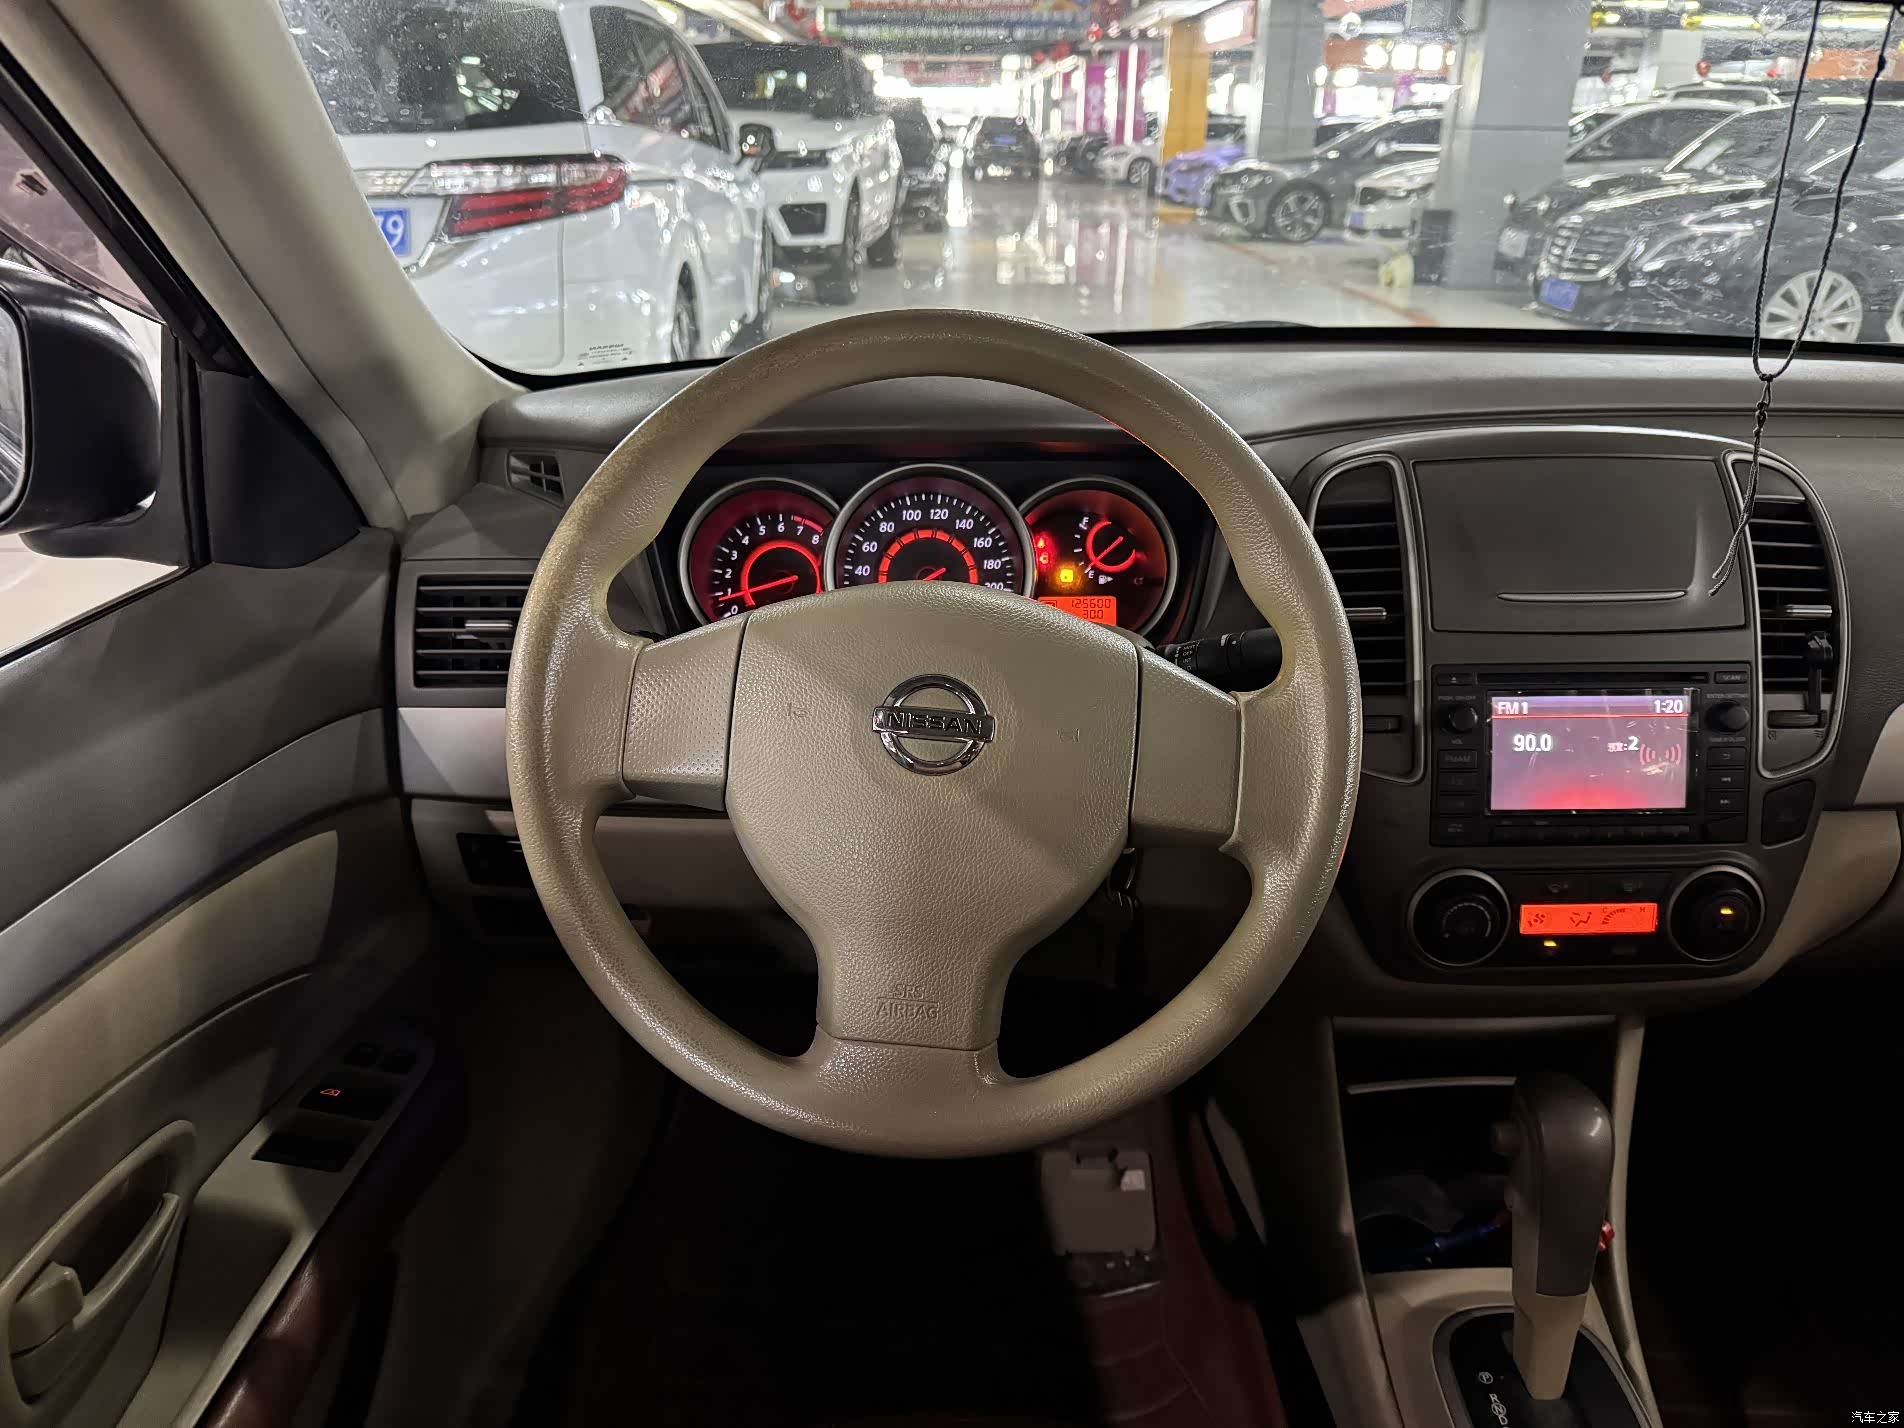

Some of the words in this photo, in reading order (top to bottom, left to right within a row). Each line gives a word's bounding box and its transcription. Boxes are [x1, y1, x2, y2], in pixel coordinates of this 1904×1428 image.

[902, 509, 922, 521] 100
[930, 508, 949, 520] 120
[955, 518, 974, 530] 140
[1082, 516, 1090, 526] F
[758, 525, 766, 536] 5
[777, 522, 785, 533] 6
[796, 525, 804, 536] 7
[879, 521, 895, 533] 80
[741, 535, 750, 545] 4
[811, 535, 820, 545] 8
[973, 537, 993, 548] 160
[861, 541, 878, 552] 60
[730, 550, 738, 560] 3
[983, 559, 1002, 570] 180
[724, 568, 732, 578] 2
[854, 565, 871, 576] 40
[1088, 570, 1095, 579] E
[1071, 598, 1111, 609] 125600
[730, 605, 738, 614] 0
[1654, 699, 1684, 714] 1:20
[887, 711, 983, 734] NISSAN
[1512, 733, 1553, 752] 90.0
